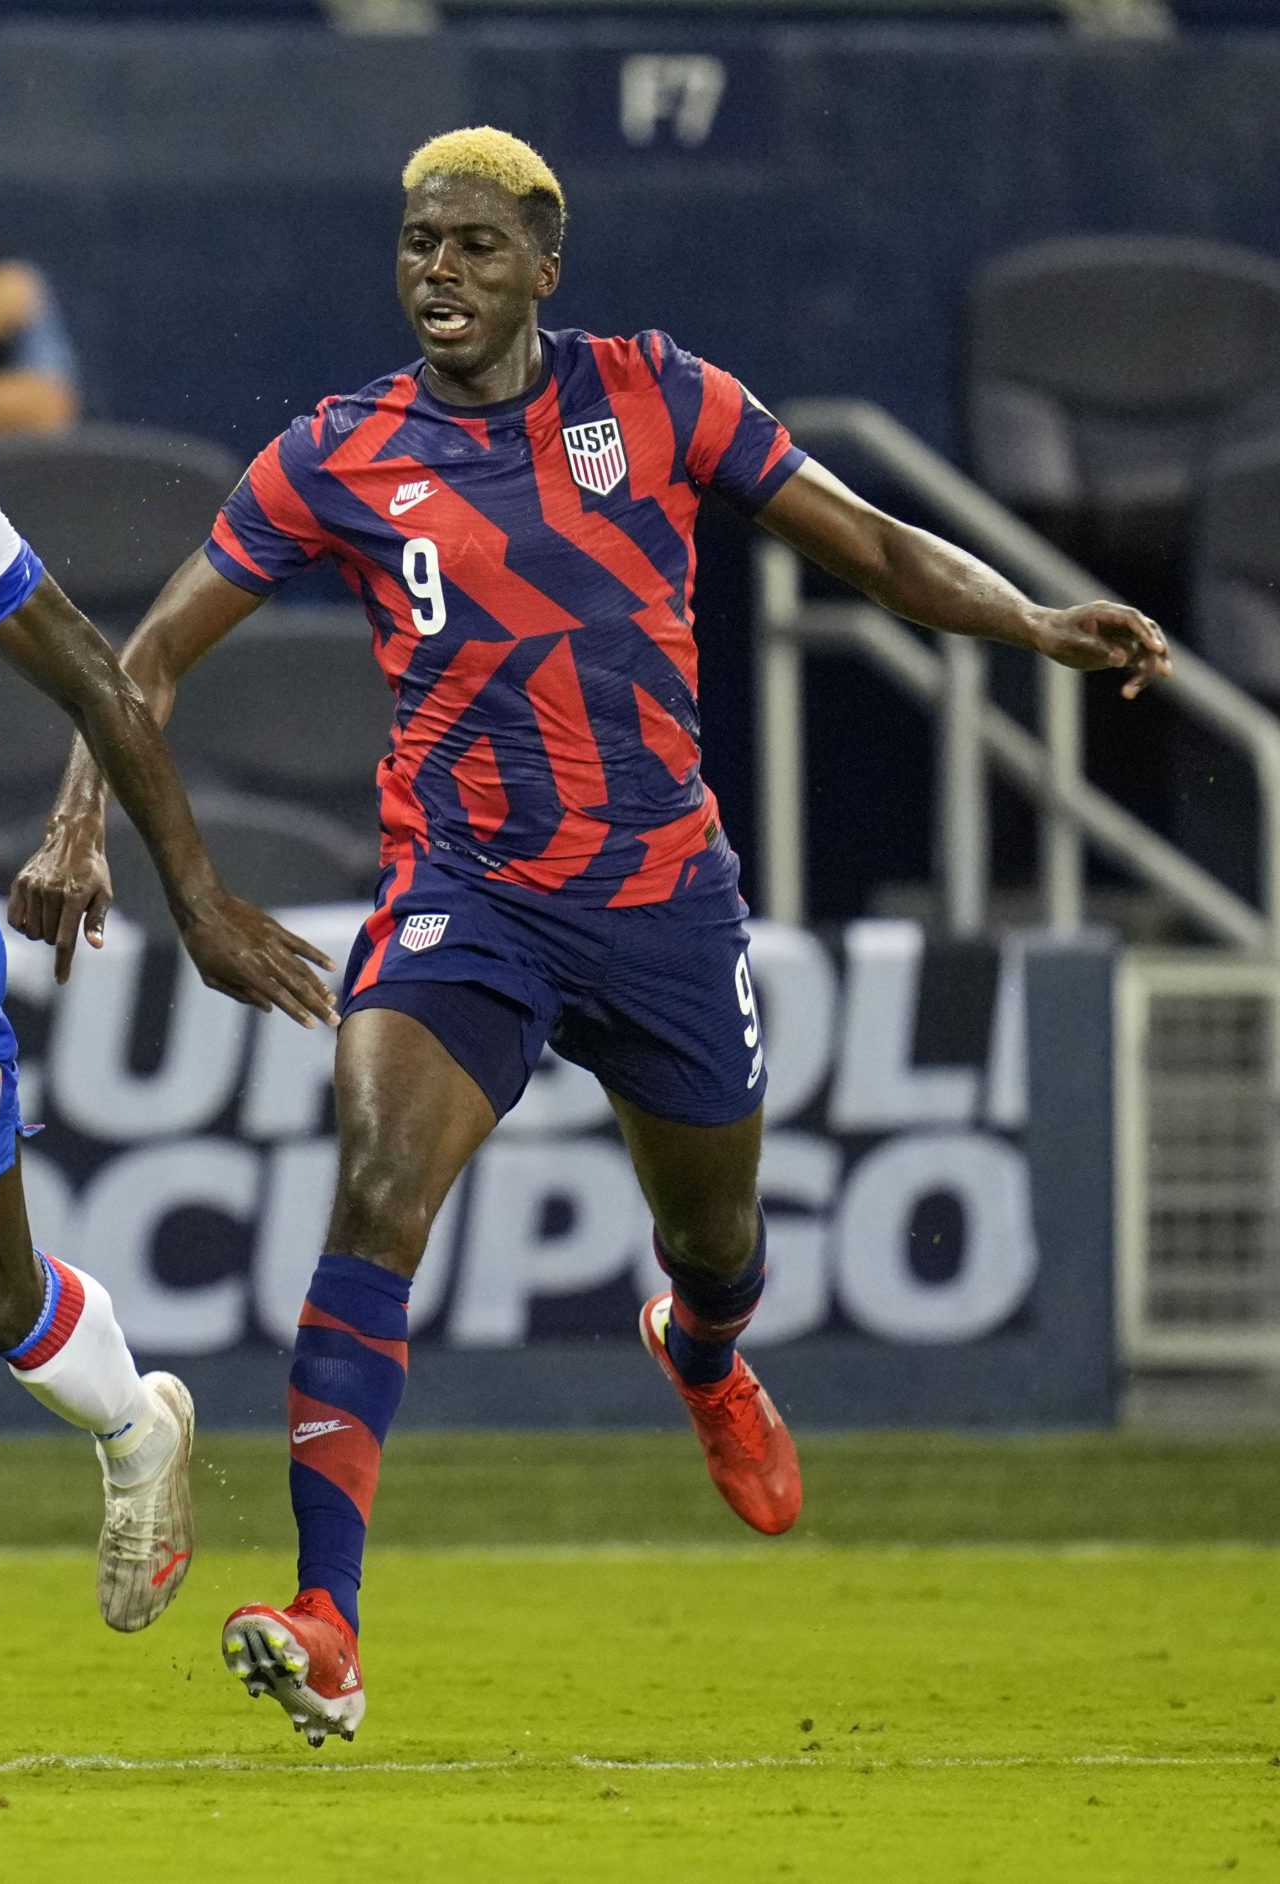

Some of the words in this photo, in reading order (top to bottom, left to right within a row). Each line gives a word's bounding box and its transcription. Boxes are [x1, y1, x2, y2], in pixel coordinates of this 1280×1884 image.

[621, 54, 725, 147] F7
[567, 422, 616, 453] USA
[395, 480, 430, 502] NIKE
[402, 537, 446, 635] 9
[408, 916, 447, 930] USA
[734, 951, 758, 1048] 9
[297, 1420, 340, 1433] NIKE
